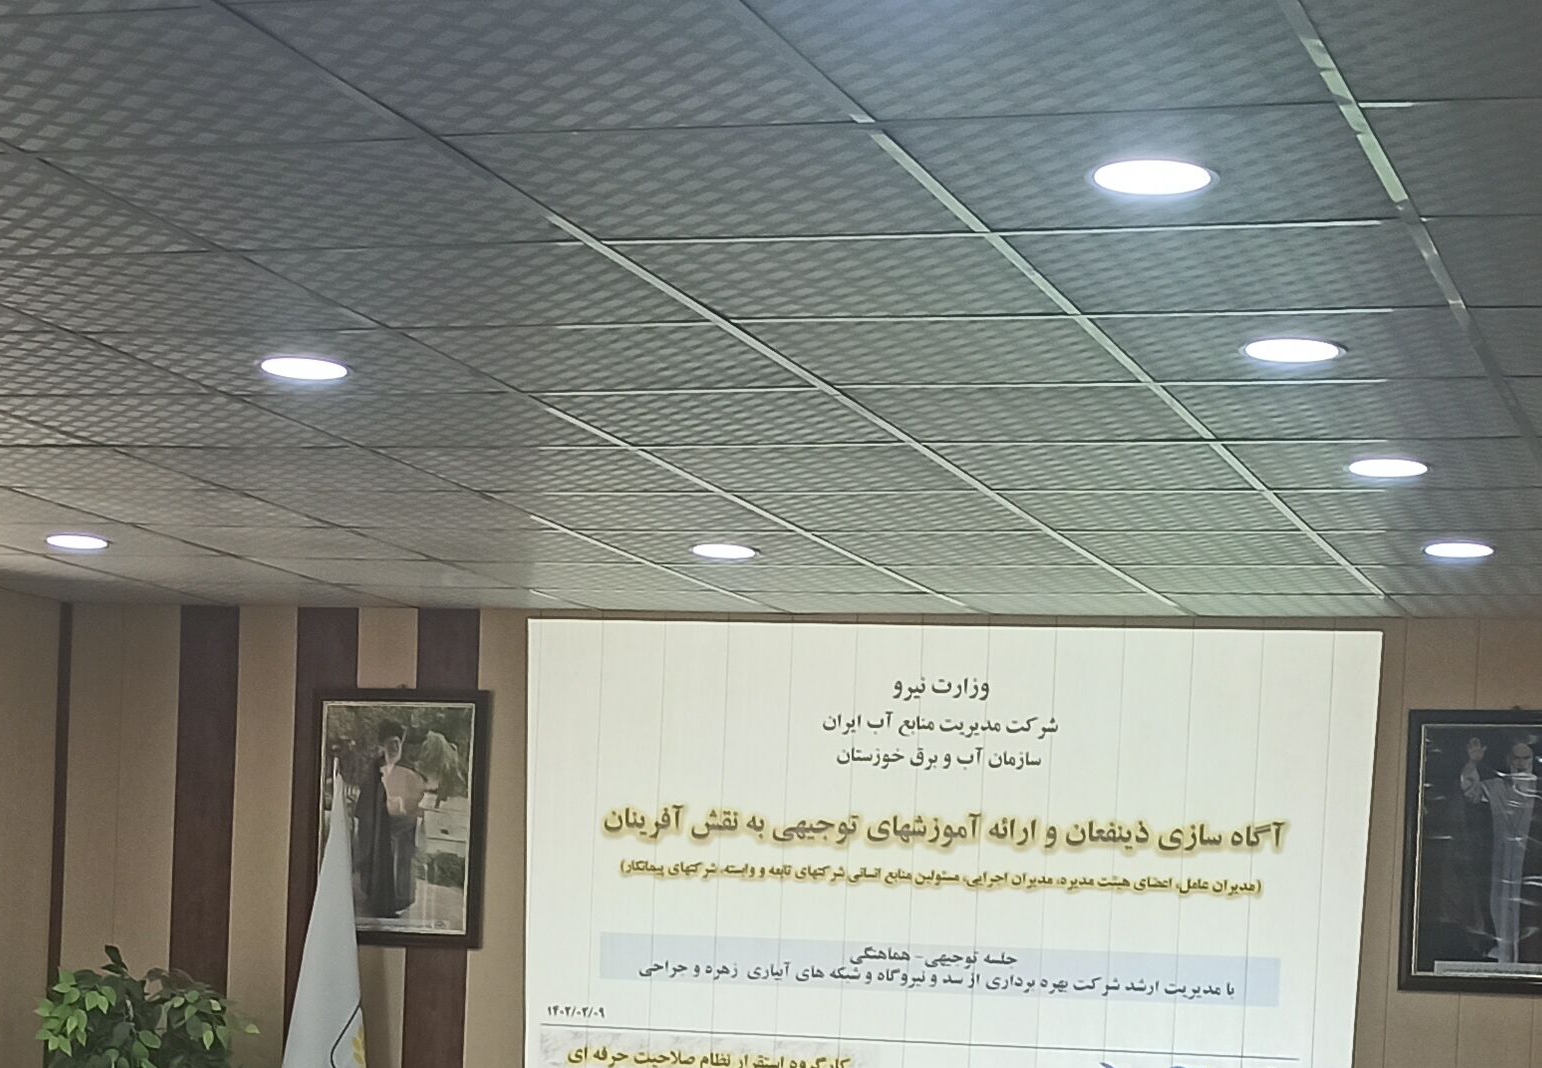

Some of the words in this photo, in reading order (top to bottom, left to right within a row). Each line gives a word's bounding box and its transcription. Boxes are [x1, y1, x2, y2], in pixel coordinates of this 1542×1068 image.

[892, 676, 926, 701] نیرو
[931, 677, 990, 701] وزارت
[822, 714, 862, 735] ایران
[866, 711, 894, 735] آب
[897, 715, 935, 737] منابع
[939, 717, 1001, 738] مدیریت
[1005, 715, 1059, 739] شرکت
[836, 747, 905, 769] خوزستان
[909, 747, 938, 770] برق
[943, 752, 952, 769] و
[956, 747, 985, 770] آب
[988, 750, 1042, 770] سازمان
[603, 804, 684, 839] آفرینان
[691, 808, 739, 839] نقش
[746, 813, 766, 835] به
[772, 814, 859, 844] توجیهی
[866, 813, 982, 847] آموزشهای
[988, 817, 1037, 847] ارائه
[1045, 827, 1058, 849] و
[1065, 819, 1150, 851] ذینفعان
[1158, 822, 1223, 851] سازی
[1230, 821, 1286, 848] آگاه
[667, 861, 717, 879] شرکتهای
[759, 865, 766, 878] و
[768, 864, 792, 878] تابعه
[795, 864, 845, 882] شرکتهای
[847, 866, 882, 883] انسانی
[884, 867, 912, 884] منابع
[1011, 872, 1053, 889] مدیران
[1133, 876, 1173, 891] اعضای
[849, 946, 910, 965] هماهنگی
[983, 951, 1018, 967] جلسه
[638, 960, 688, 979] جراحی
[693, 963, 700, 978] و
[705, 961, 739, 981] زهره
[747, 961, 790, 981] آبیاری
[795, 965, 825, 981] های
[829, 966, 860, 982] شبکه
[864, 970, 873, 985] و
[876, 967, 926, 989] نیروگاه
[930, 971, 938, 987] و
[942, 974, 964, 985] سد
[967, 971, 980, 989] از
[985, 973, 1036, 994] برداری
[1039, 976, 1069, 995] بهره
[1072, 975, 1120, 997] شرکت
[1124, 977, 1159, 996] ارشد
[1225, 980, 1235, 999] با
[1163, 982, 1222, 1000] مدیریت
[567, 1045, 588, 1065] ای
[633, 1047, 695, 1067] صلاحیت
